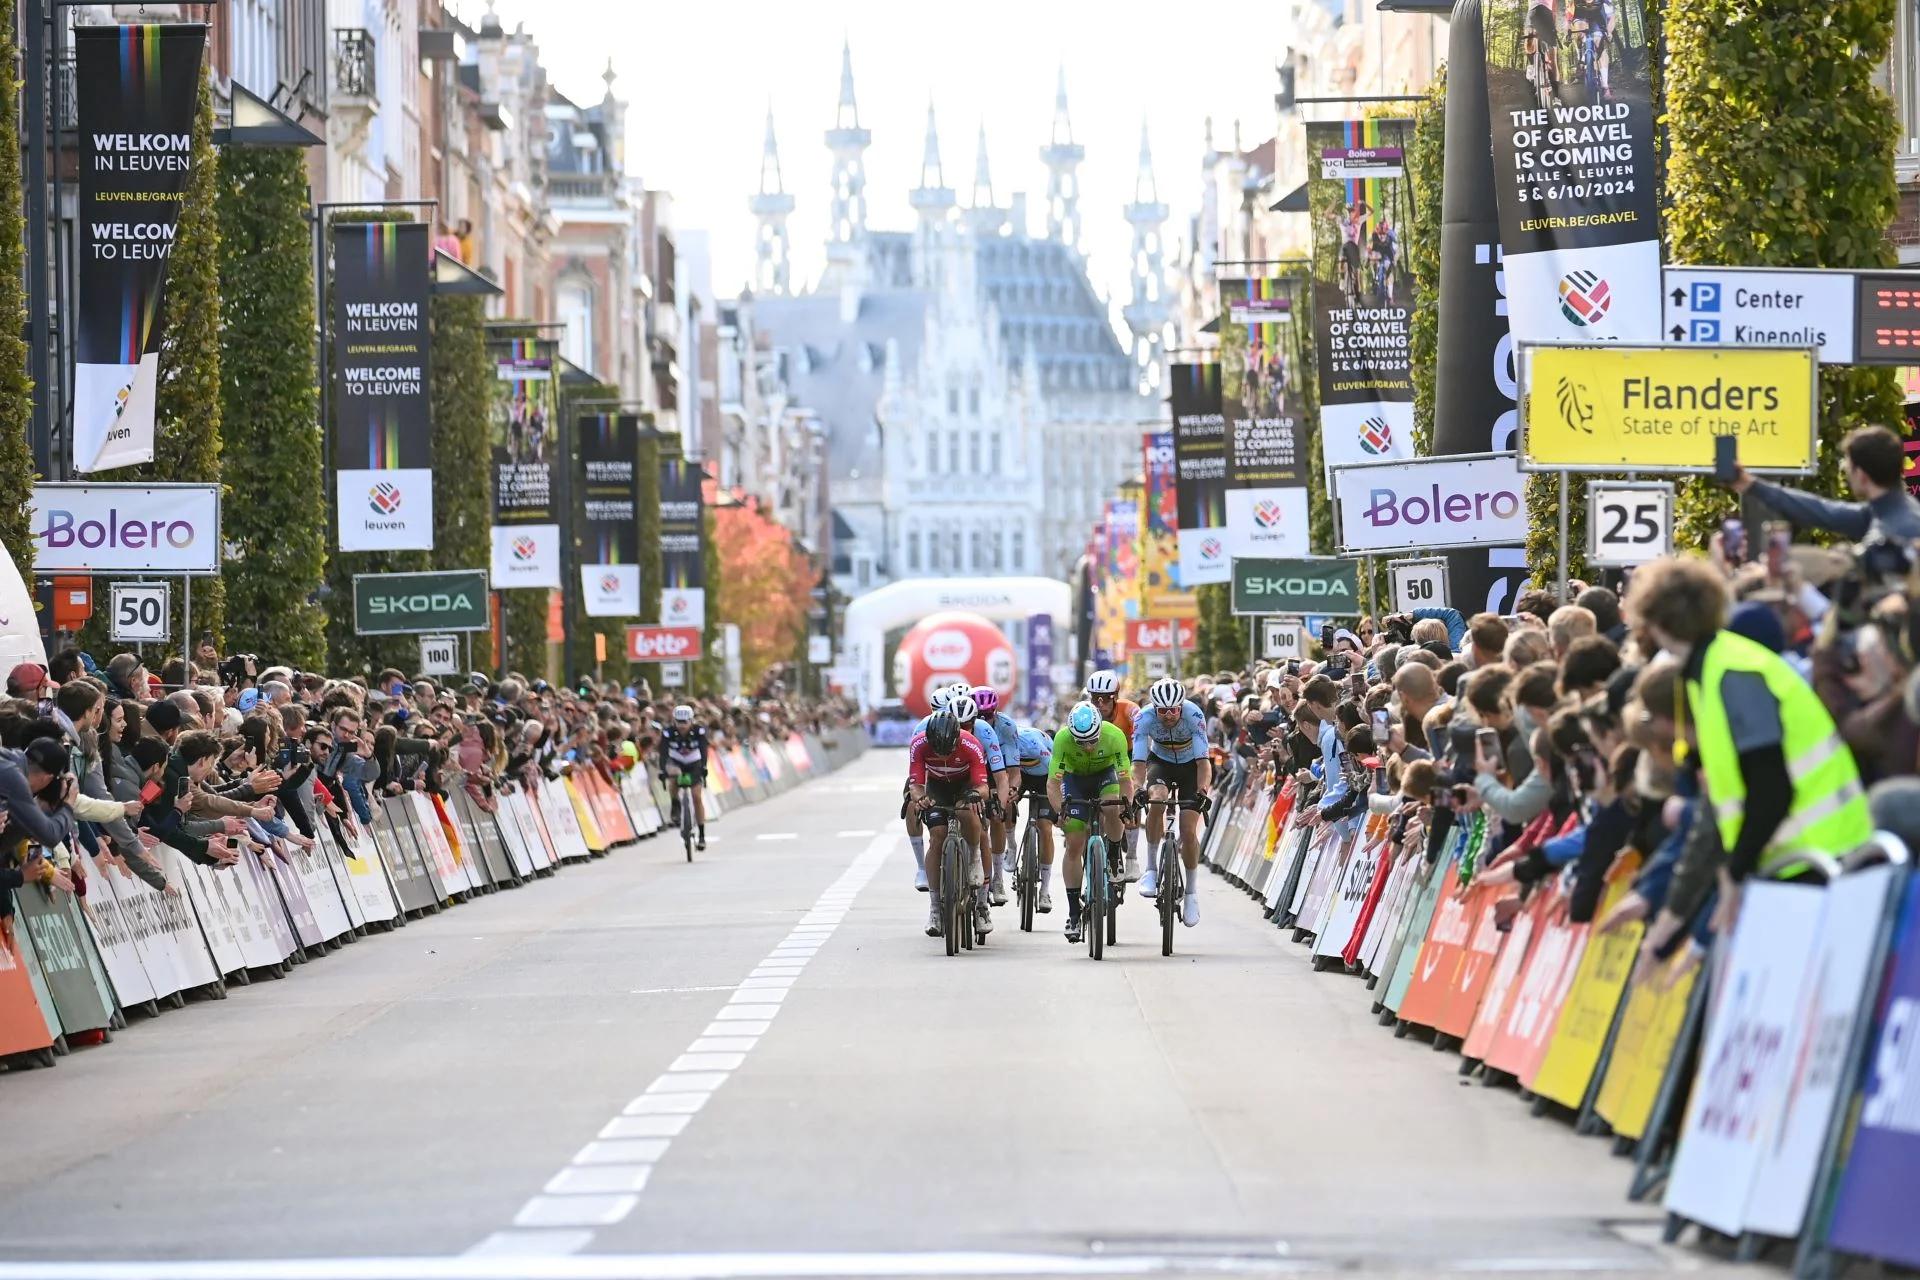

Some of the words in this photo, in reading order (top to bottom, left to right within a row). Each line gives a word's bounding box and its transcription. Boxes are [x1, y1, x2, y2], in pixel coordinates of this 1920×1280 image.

[1510, 109, 1548, 127] THE
[1554, 103, 1629, 123] WORLD
[93, 134, 190, 151] WELKOM
[1513, 130, 1542, 147] OF
[1548, 123, 1632, 145] GRAVEL
[1348, 149, 1376, 158] Bolero
[1515, 151, 1535, 169] IS
[1540, 143, 1633, 167] COMING
[95, 155, 113, 171] IN
[120, 155, 190, 171] LEUVEN
[1516, 171, 1560, 183] HALLE
[1579, 165, 1634, 179] LEUVEN
[95, 192, 184, 201] LEUVEN.BE/GRAVE
[1518, 189, 1527, 202] 5
[1532, 187, 1543, 200] &
[1547, 180, 1635, 200] 6/10/2024
[1520, 211, 1638, 232] LEUVEN.BE/GRAVEL
[92, 223, 177, 240] WELCOM
[92, 244, 116, 259] TO
[123, 244, 171, 259] LEUV
[1735, 288, 1804, 309] Center
[346, 303, 418, 317] WELKOM
[1328, 309, 1354, 321] THE
[1356, 308, 1407, 320] WORLD
[347, 318, 361, 331] IN
[366, 318, 418, 331] LEUVEN
[1330, 323, 1350, 335] OF
[1353, 322, 1407, 334] GRAVEL
[1331, 337, 1344, 350] IS
[1348, 335, 1407, 348] COMING
[1331, 350, 1361, 359] HALLE
[1370, 350, 1407, 358] LEUVEN
[345, 367, 421, 381] WELCOME
[1332, 362, 1339, 372] 5
[1342, 361, 1350, 370] &
[1353, 360, 1408, 370] 6/10/2024
[346, 382, 364, 395] TO
[368, 382, 420, 395] LEUVEN
[1623, 377, 1779, 411] Flanders
[1233, 419, 1253, 429] THE
[1255, 418, 1294, 428] WORLD
[1623, 418, 1672, 435] State
[1681, 417, 1700, 435] of
[1709, 416, 1741, 436] the
[1747, 418, 1779, 436] Art
[106, 428, 130, 444] uven
[1234, 430, 1249, 439] OF
[1251, 429, 1294, 439] GRAVEL
[1235, 440, 1245, 449] IS
[1246, 438, 1294, 449] COMING
[1363, 483, 1519, 527] Bolero
[40, 509, 195, 549] Bolero
[365, 520, 405, 530] leuven
[1601, 504, 1660, 544] 25
[1245, 577, 1349, 596] SKODA
[1407, 578, 1433, 599] 50
[118, 597, 161, 626] 50
[369, 593, 472, 614] SKODA
[1272, 634, 1294, 647] 100
[427, 649, 449, 663] 100
[1166, 818, 1174, 830] 7
[29, 913, 86, 973] SKODA
